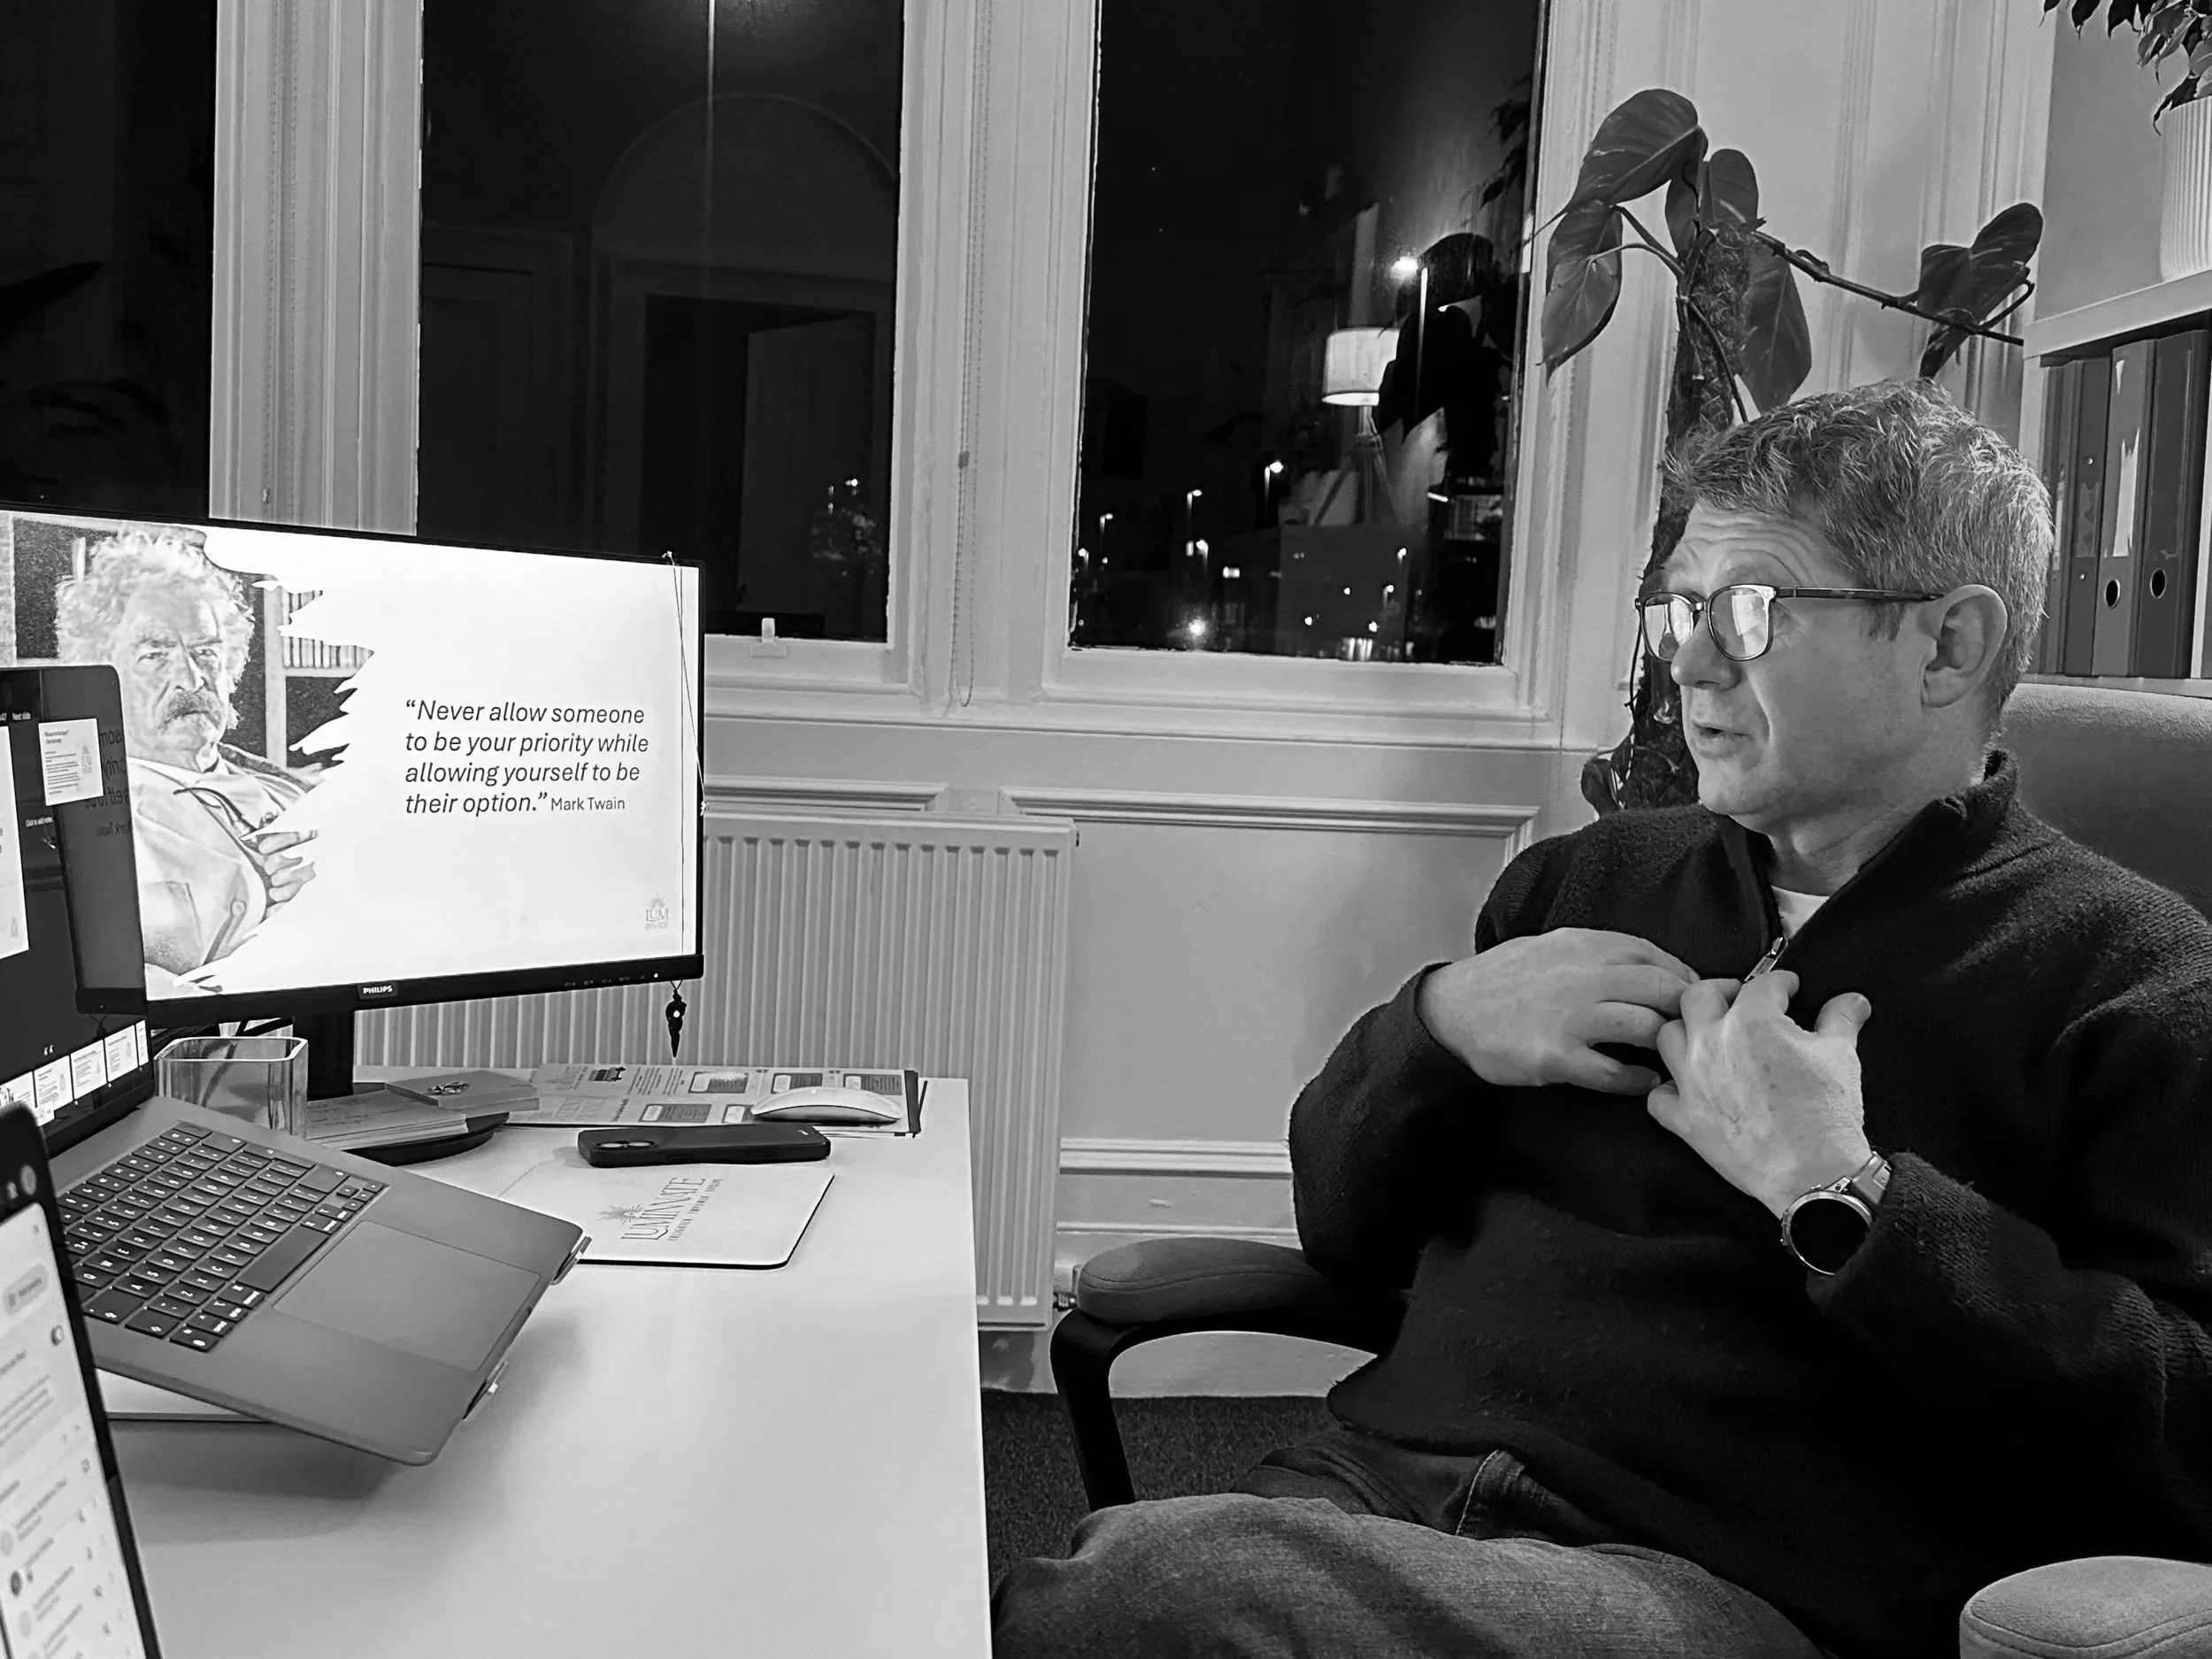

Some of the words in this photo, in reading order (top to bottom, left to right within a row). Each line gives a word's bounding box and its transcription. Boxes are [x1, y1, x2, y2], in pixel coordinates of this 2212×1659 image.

[489, 702, 547, 721] allow
[551, 708, 644, 724] someone
[406, 733, 426, 751] to
[434, 731, 461, 751] be
[466, 737, 516, 756] your
[519, 733, 594, 757] priority
[598, 733, 648, 752] while
[405, 762, 499, 787] allowing
[503, 763, 589, 787] yourself
[593, 764, 611, 780] to
[617, 762, 640, 780] be
[406, 793, 458, 813] their
[551, 797, 584, 810] Mark
[588, 797, 625, 810] Twain
[362, 985, 394, 995] PHILIPS
